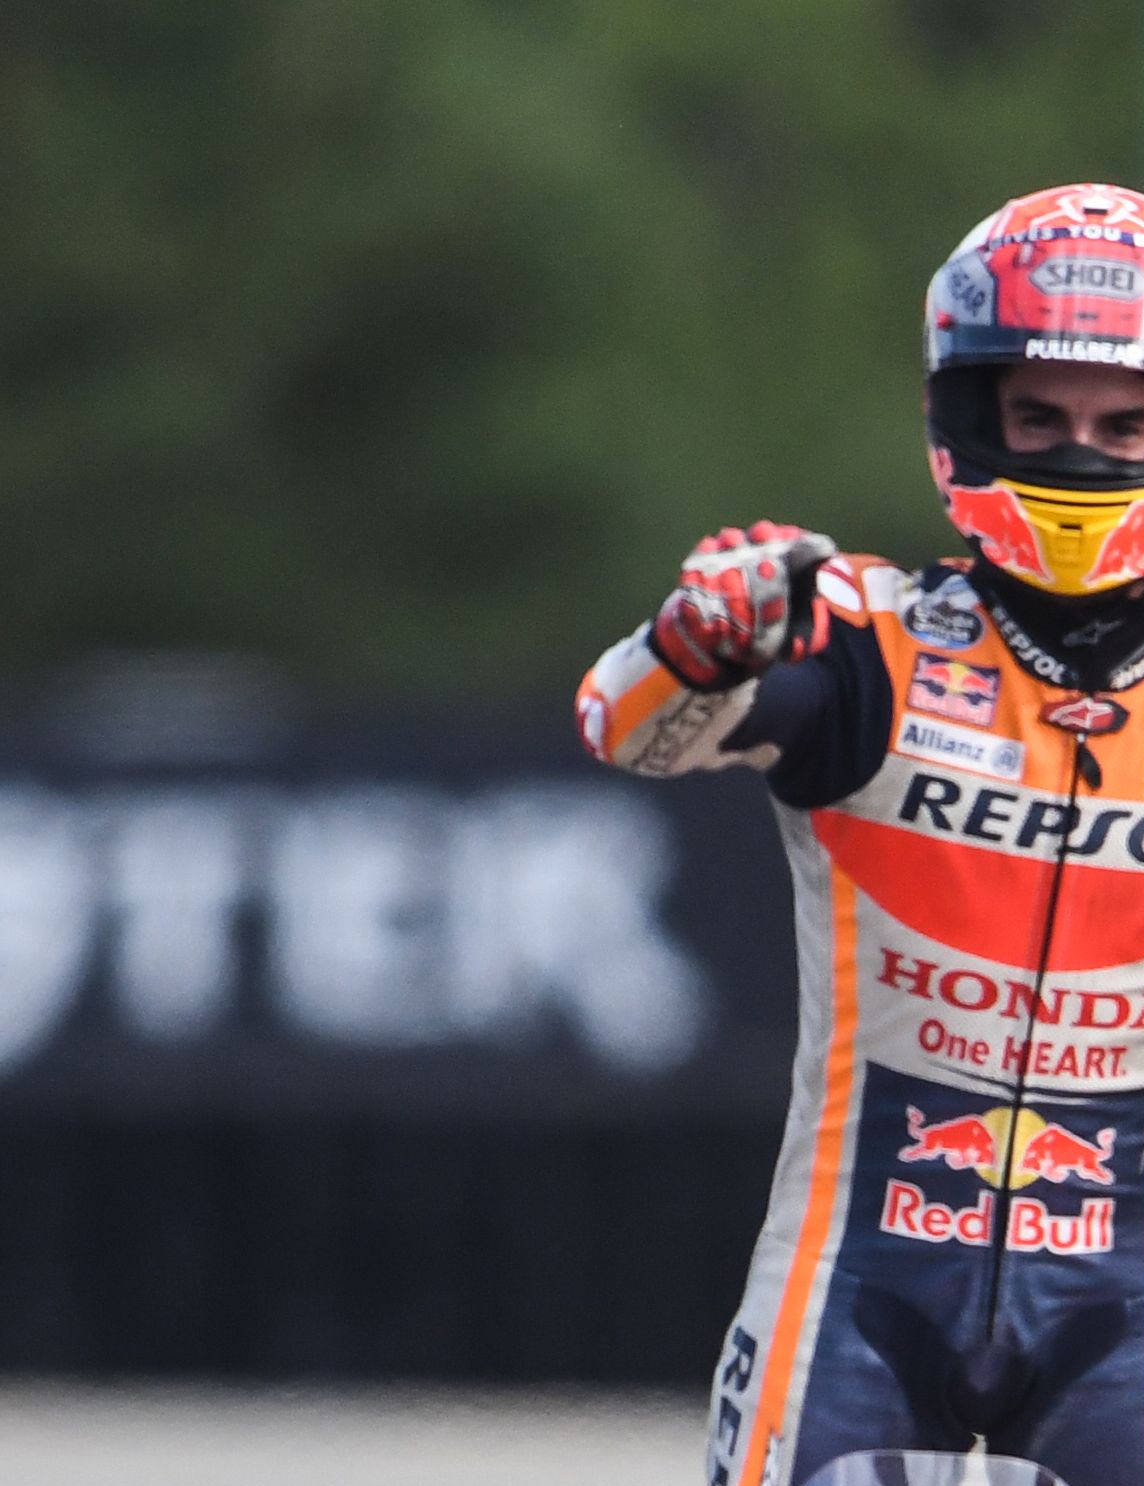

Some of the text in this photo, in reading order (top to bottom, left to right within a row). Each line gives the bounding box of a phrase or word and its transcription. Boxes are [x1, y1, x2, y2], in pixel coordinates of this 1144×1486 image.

[1070, 224, 1122, 241] YOU
[1047, 262, 1135, 291] SHOEI
[902, 723, 986, 760] Allianz
[918, 1018, 991, 1065] One
[880, 1178, 1115, 1255] Red Bull
